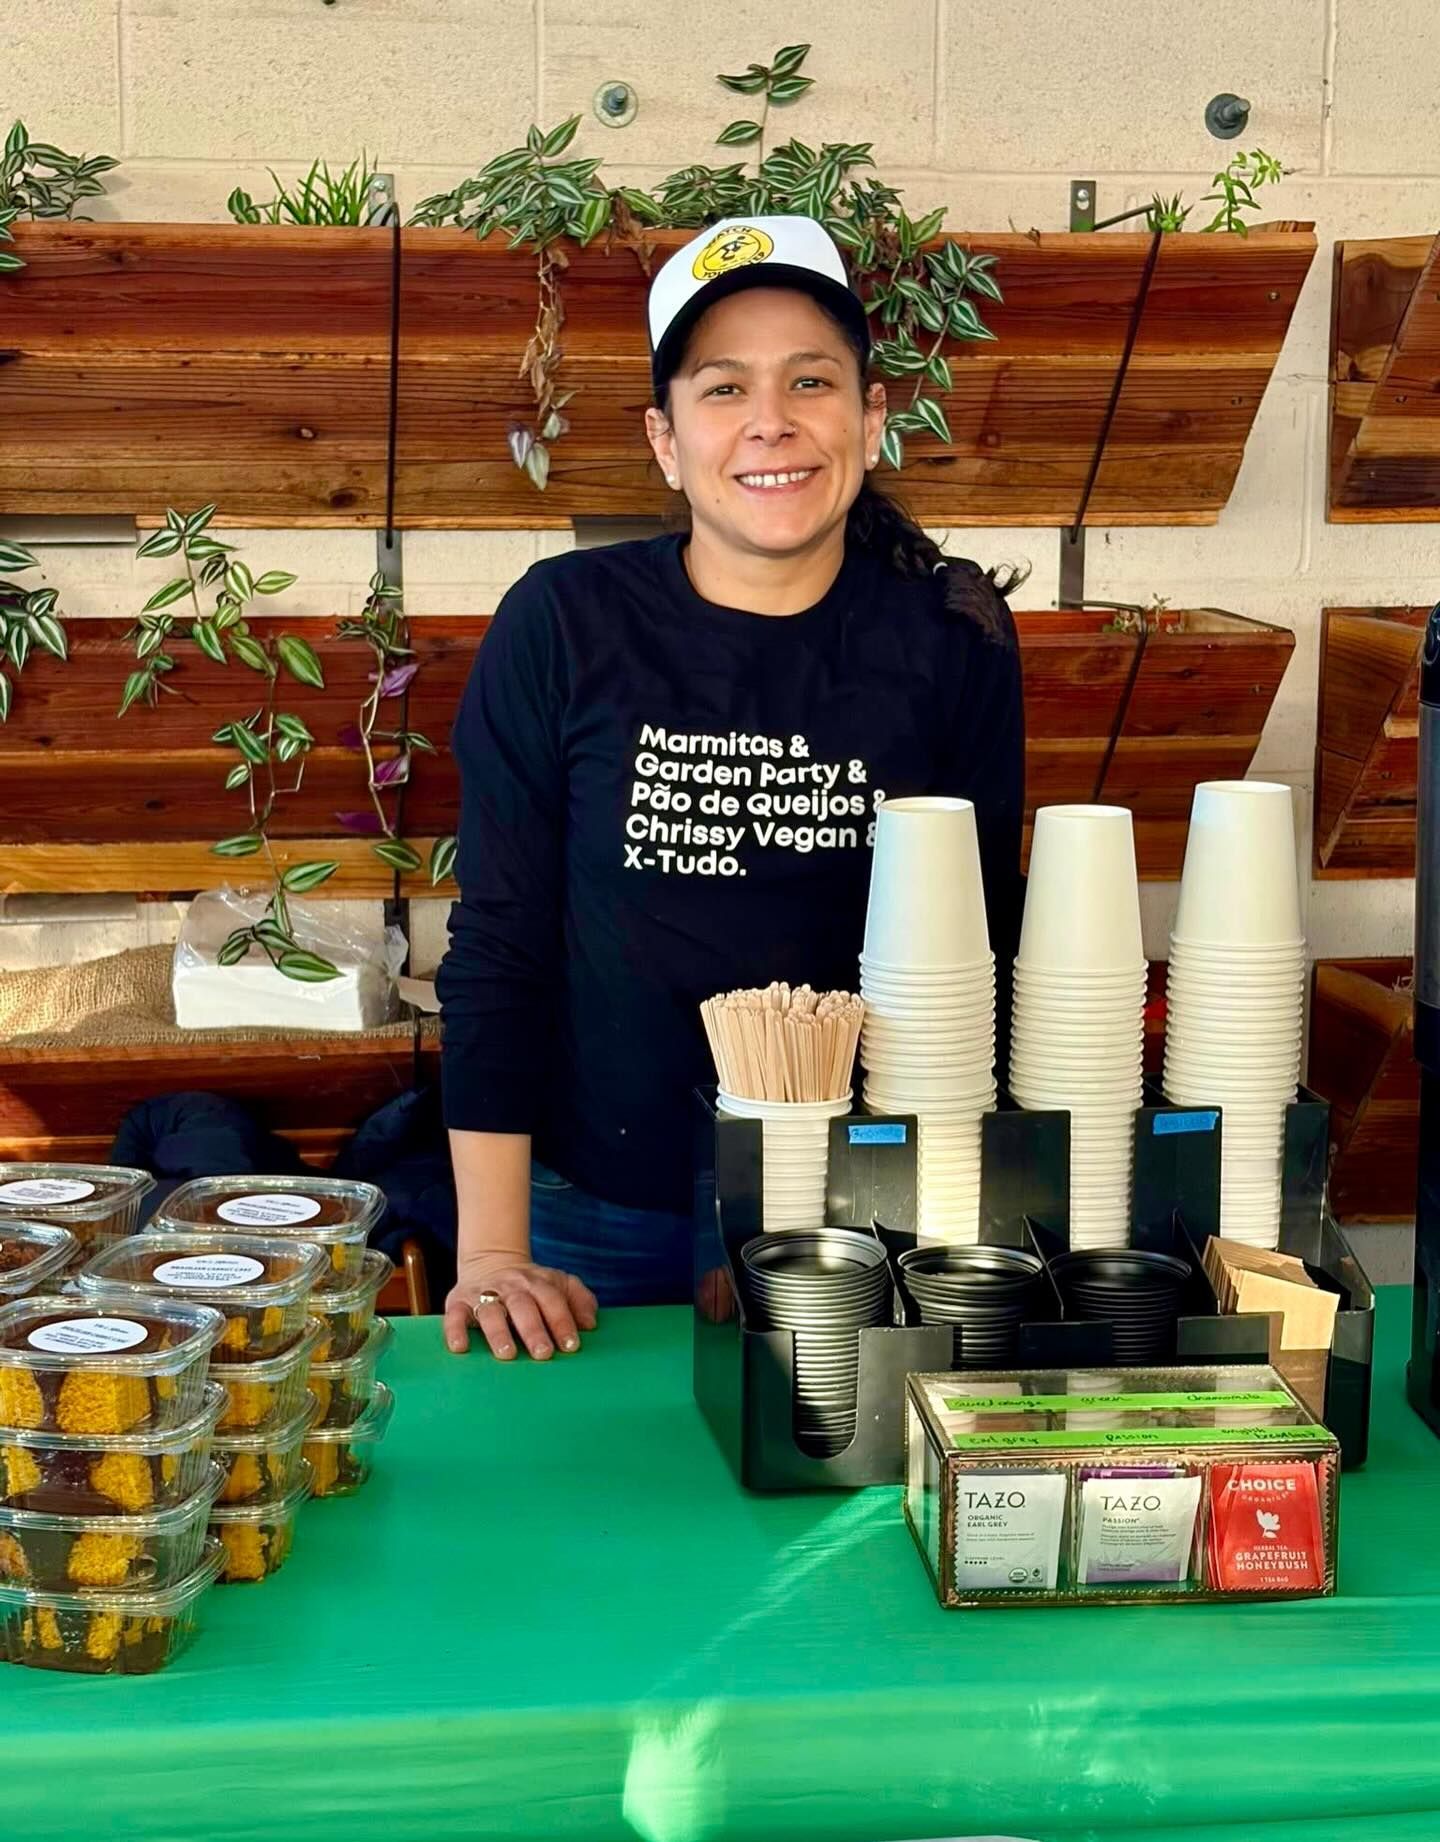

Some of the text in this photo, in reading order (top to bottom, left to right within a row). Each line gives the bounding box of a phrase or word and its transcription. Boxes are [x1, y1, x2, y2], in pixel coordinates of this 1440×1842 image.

[639, 724, 810, 758] Marmitas &
[634, 752, 867, 789] Garden Party &
[630, 781, 692, 812] Pão
[699, 790, 740, 816] de
[747, 789, 866, 821] Queijos
[625, 813, 746, 851] Chrissy
[753, 821, 857, 853] Vegan
[623, 843, 747, 877] X-Tudo.
[1228, 1479, 1296, 1491] CHOICE
[964, 1491, 1025, 1509] TAZO
[1100, 1495, 1161, 1511] TAZO
[1235, 1551, 1307, 1561] GRAPEFRUIT
[1236, 1560, 1309, 1570] HONEYBUSH
